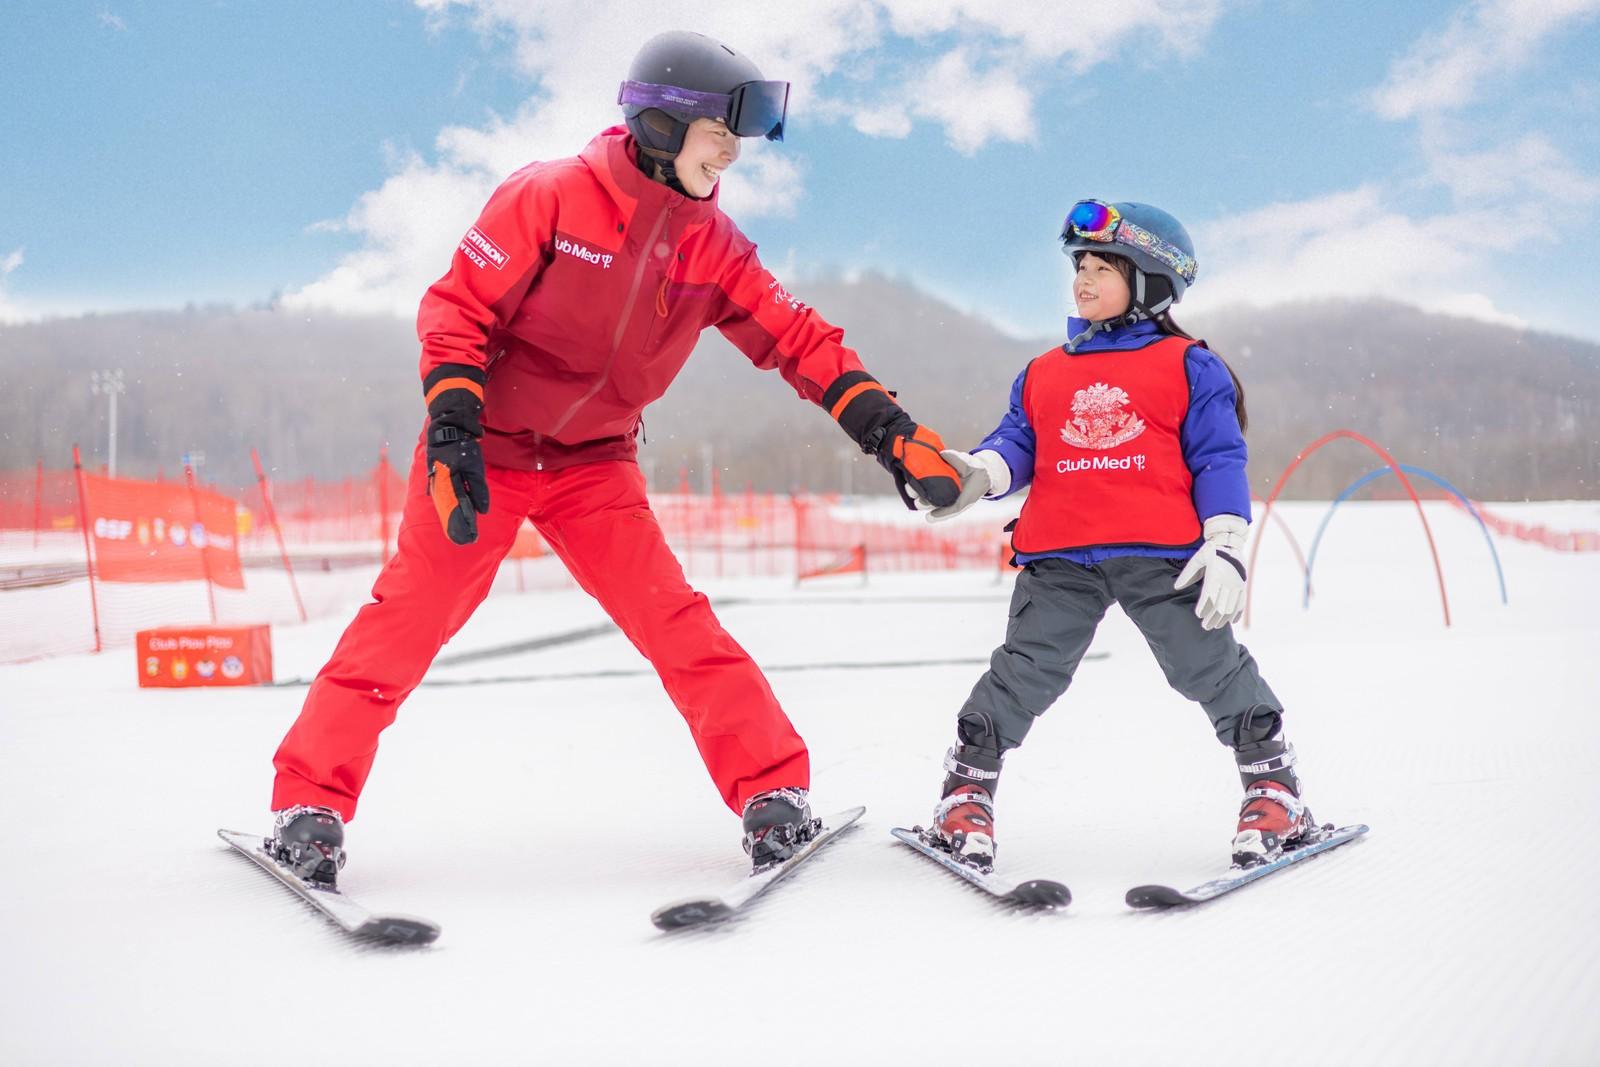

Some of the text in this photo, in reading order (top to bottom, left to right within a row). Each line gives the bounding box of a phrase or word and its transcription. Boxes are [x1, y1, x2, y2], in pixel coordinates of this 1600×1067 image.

[466, 228, 505, 264] CATHLON
[555, 235, 601, 264] ub Med
[1056, 456, 1131, 474] Club Med
[149, 638, 177, 651] Club
